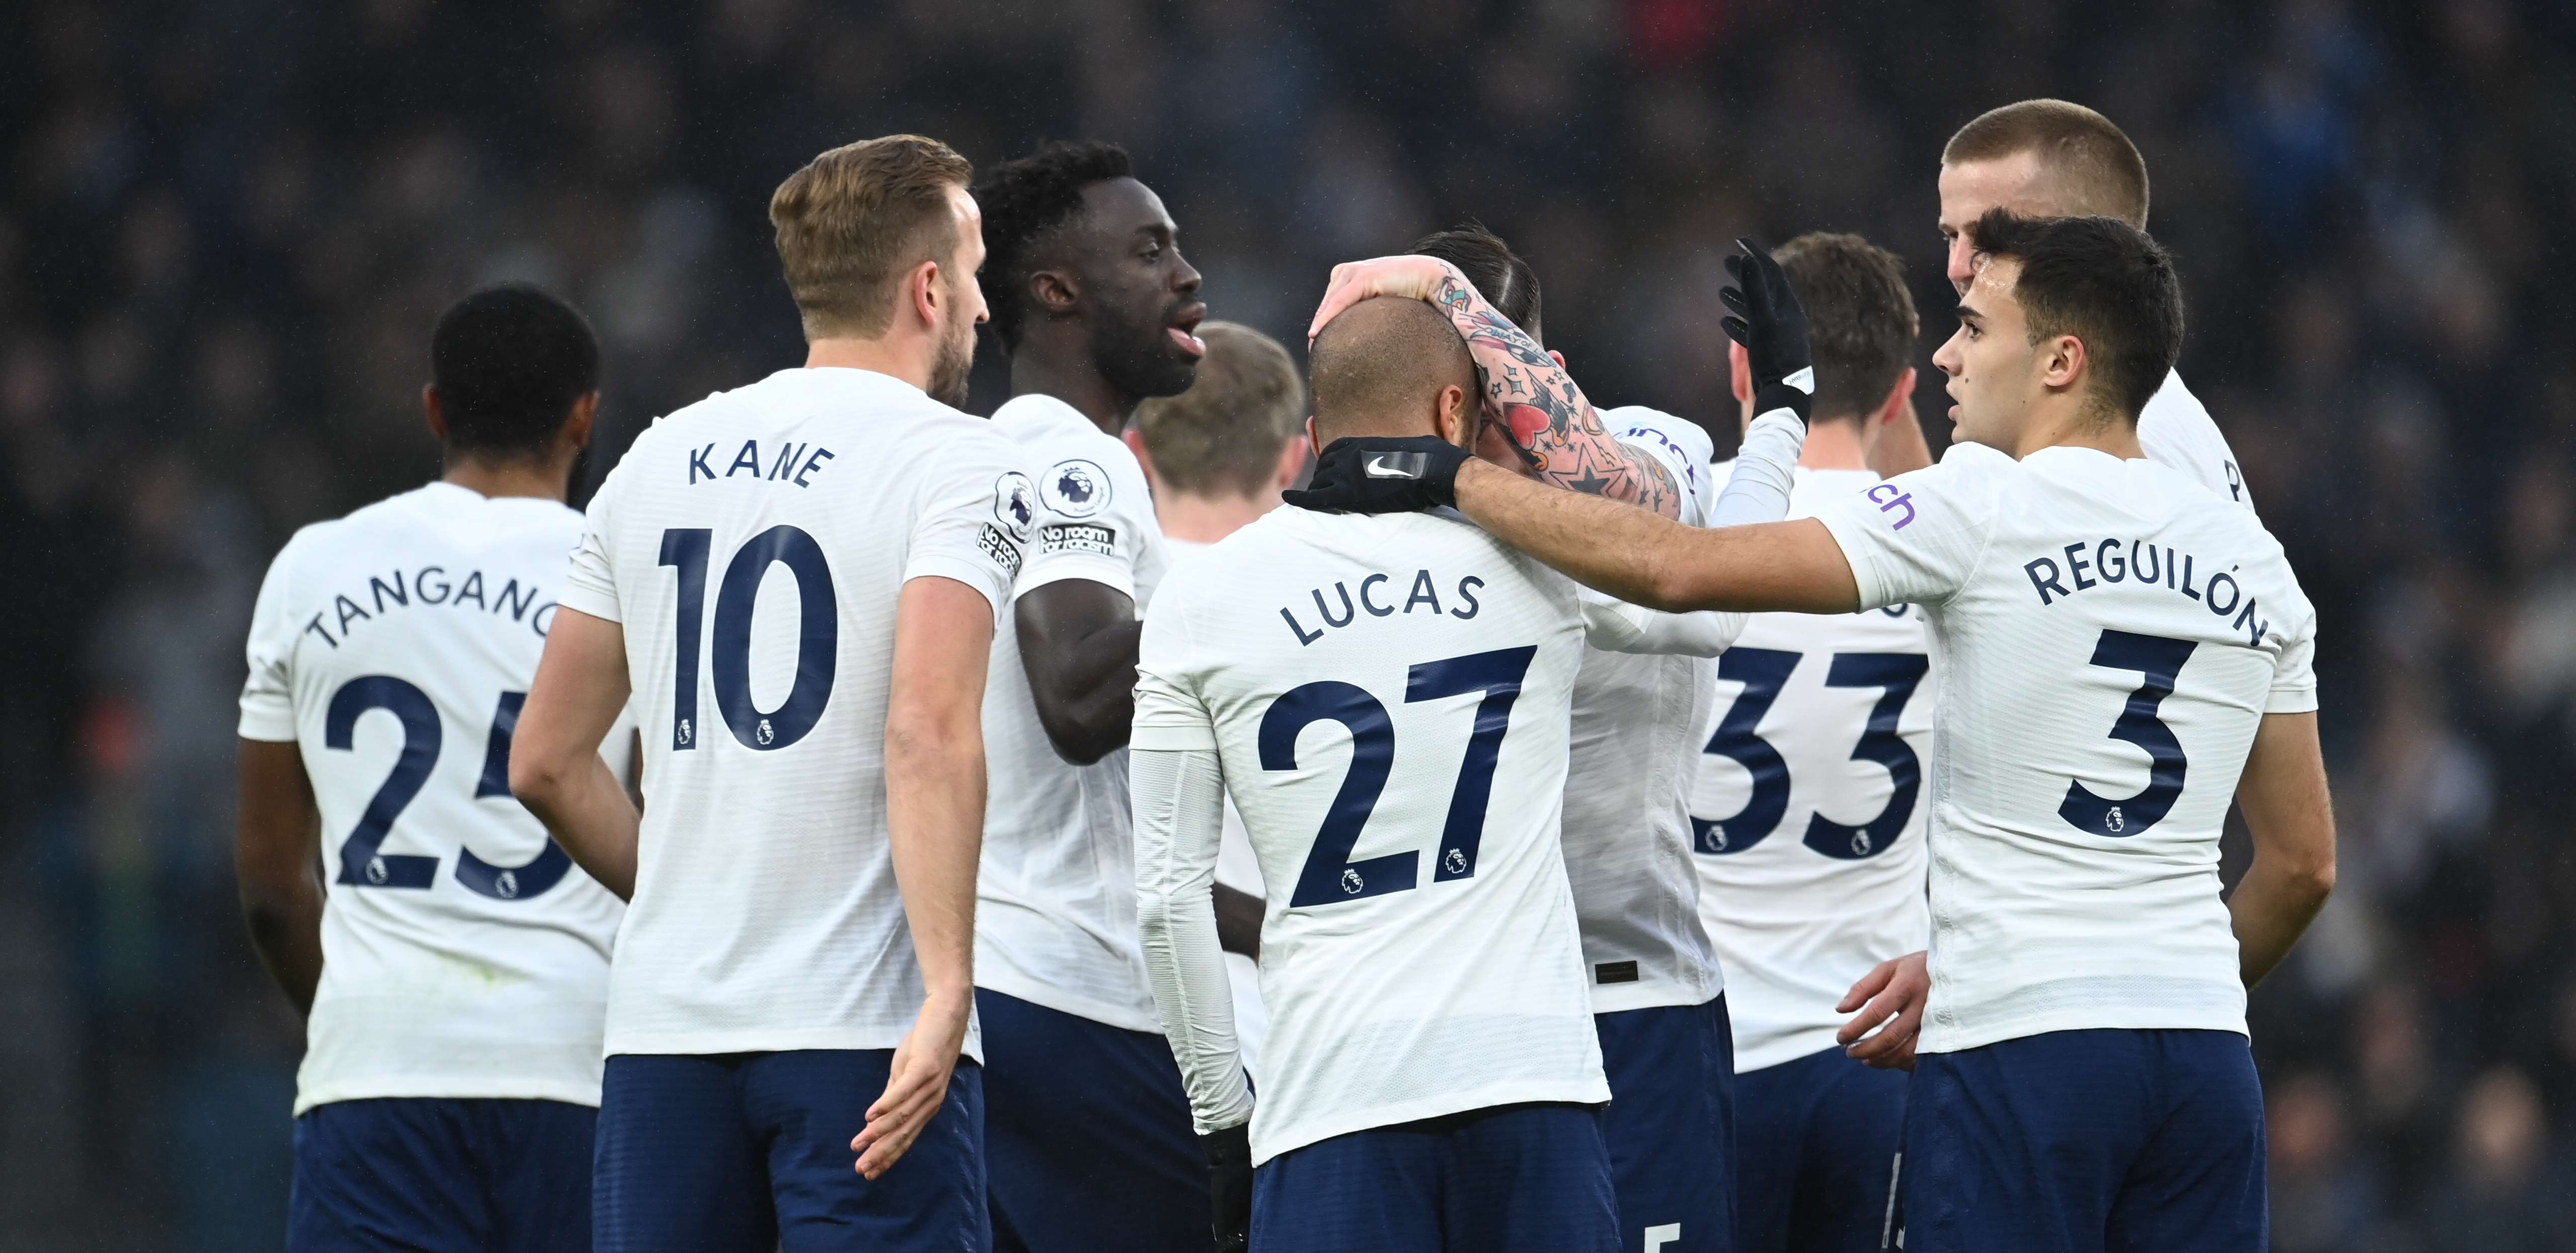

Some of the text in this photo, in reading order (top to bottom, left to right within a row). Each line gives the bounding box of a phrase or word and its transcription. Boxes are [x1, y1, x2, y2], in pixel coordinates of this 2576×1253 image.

[689, 439, 836, 489] KANE
[979, 522, 999, 545] No
[1039, 527, 1064, 541] No
[1064, 527, 1109, 543] room
[1858, 483, 1915, 531] ch
[1062, 538, 1113, 556] racism
[1279, 569, 1486, 647] LUCAS
[2024, 538, 2269, 647] REGUILÓN
[658, 525, 838, 751] 10
[1689, 646, 1930, 861] 33
[2057, 628, 2200, 838] 3
[1258, 644, 1538, 908] 27
